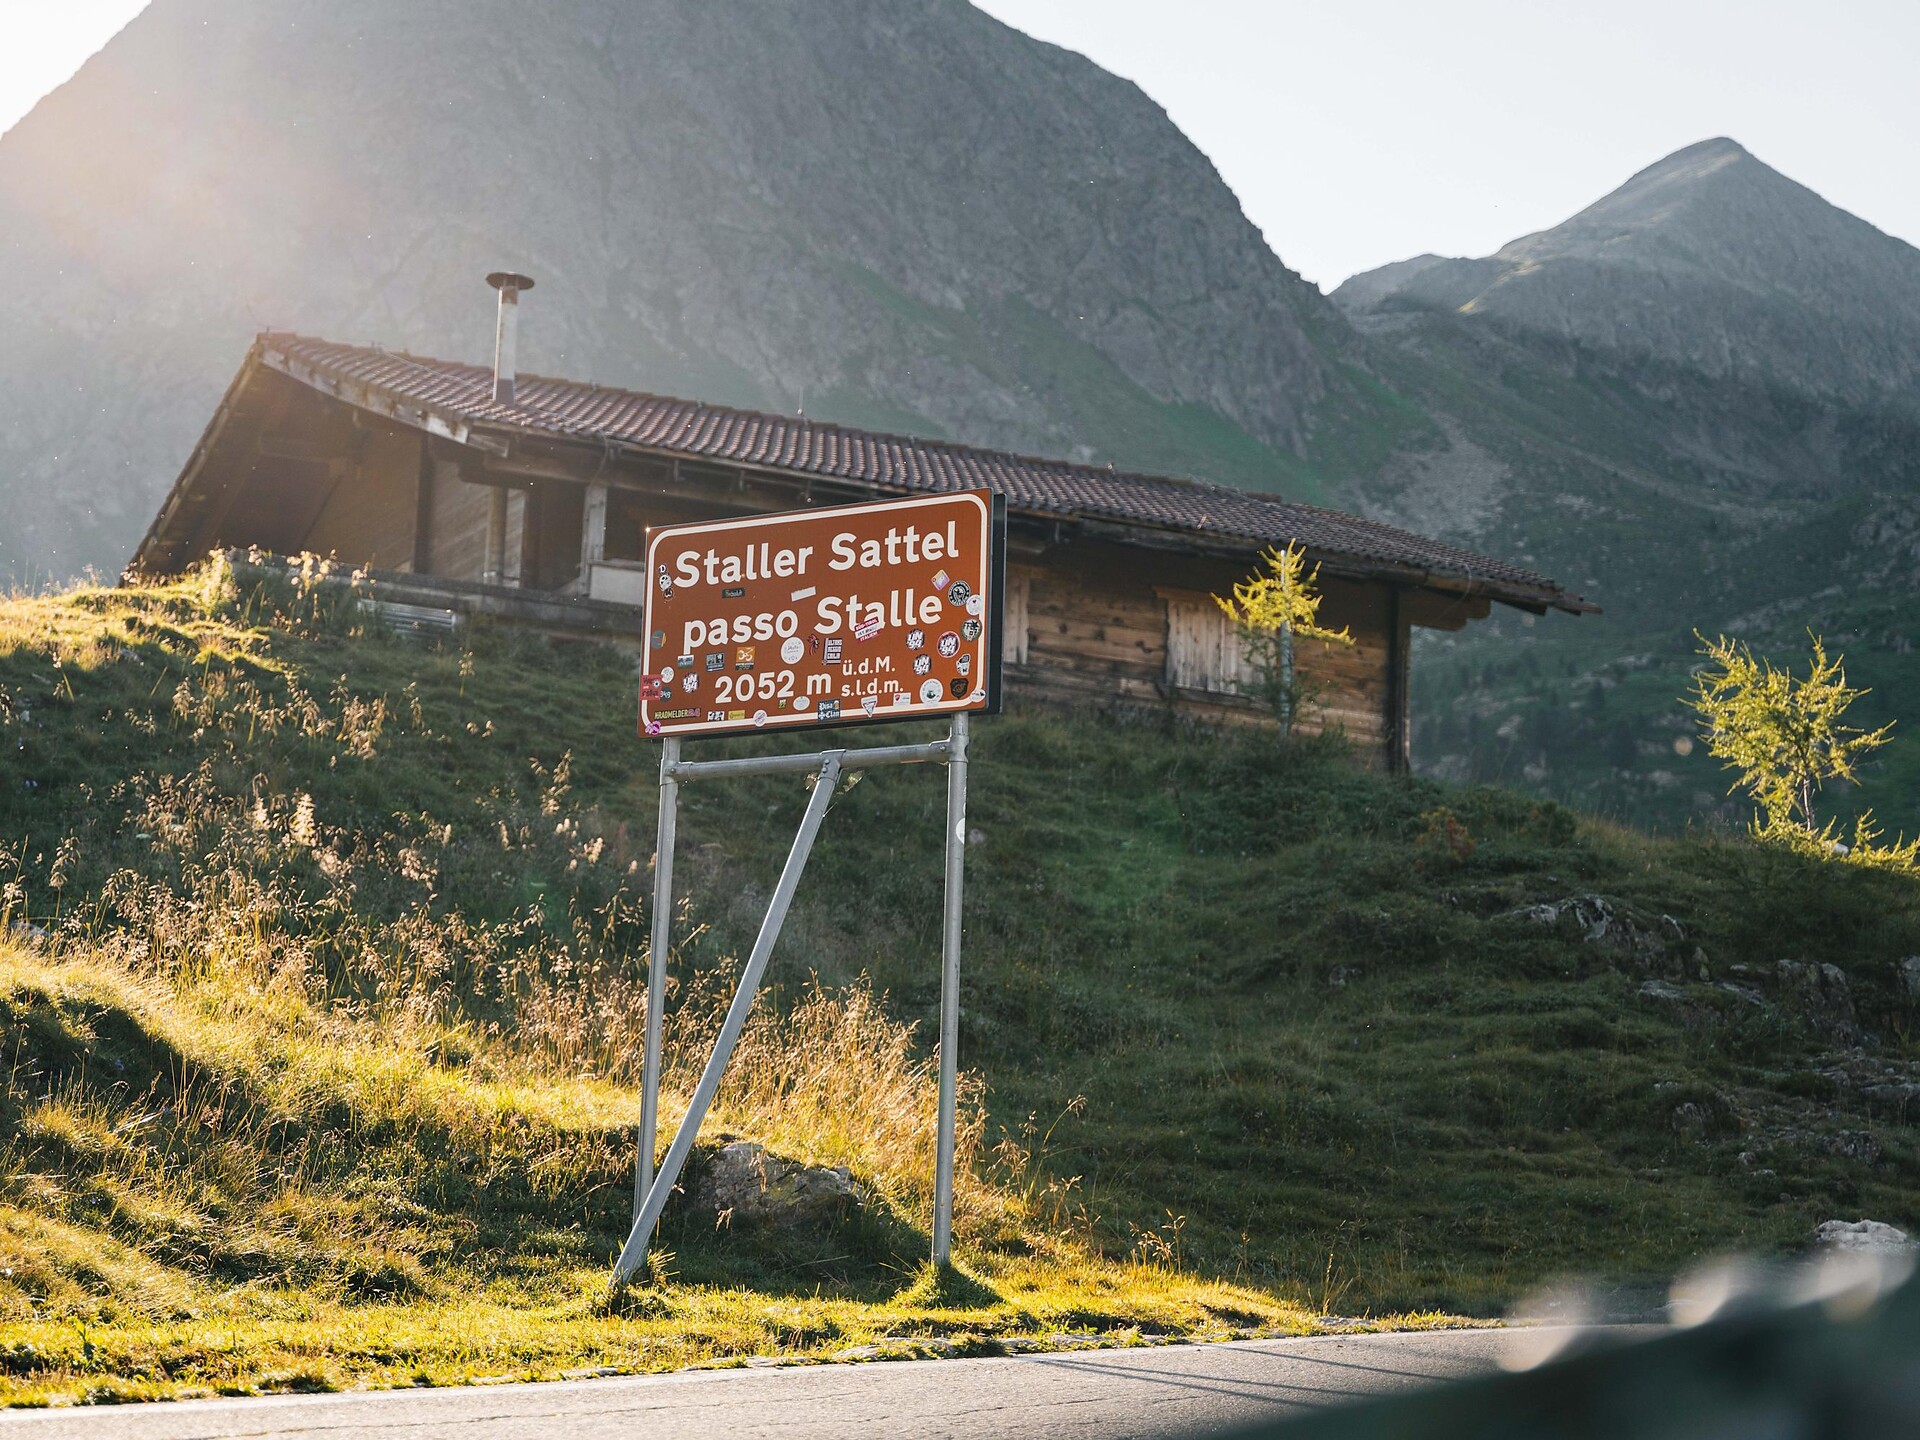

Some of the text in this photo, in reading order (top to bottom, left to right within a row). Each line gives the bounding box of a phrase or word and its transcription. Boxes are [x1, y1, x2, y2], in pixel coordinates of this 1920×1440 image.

[673, 520, 959, 588] Staller Sattel
[683, 609, 799, 655] passo
[814, 588, 943, 634] Stalle
[715, 670, 832, 704] 2052 m
[842, 655, 896, 677] ü.d.M.
